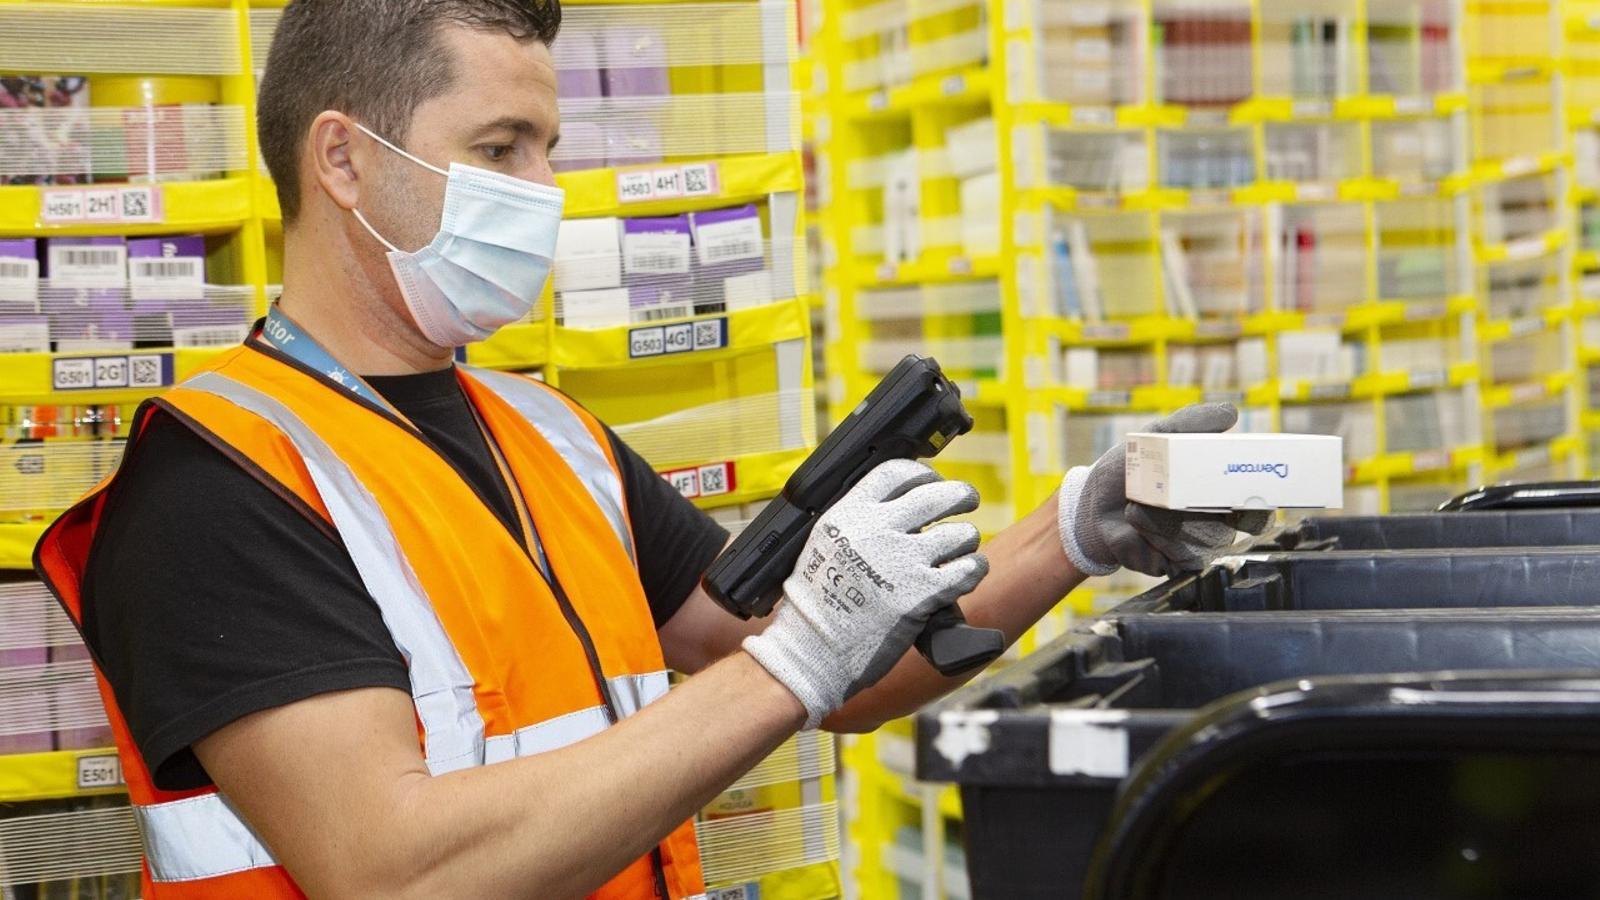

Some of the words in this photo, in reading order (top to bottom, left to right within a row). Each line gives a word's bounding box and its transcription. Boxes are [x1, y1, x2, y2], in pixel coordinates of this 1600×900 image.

[622, 182, 651, 196] H503
[656, 176, 673, 191] 4H
[48, 203, 80, 216] H501
[89, 197, 110, 213] 2H
[632, 339, 662, 353] G503
[667, 332, 686, 346] 4G
[58, 371, 90, 384] G501
[98, 365, 119, 380] 2G
[82, 768, 114, 783] E501
